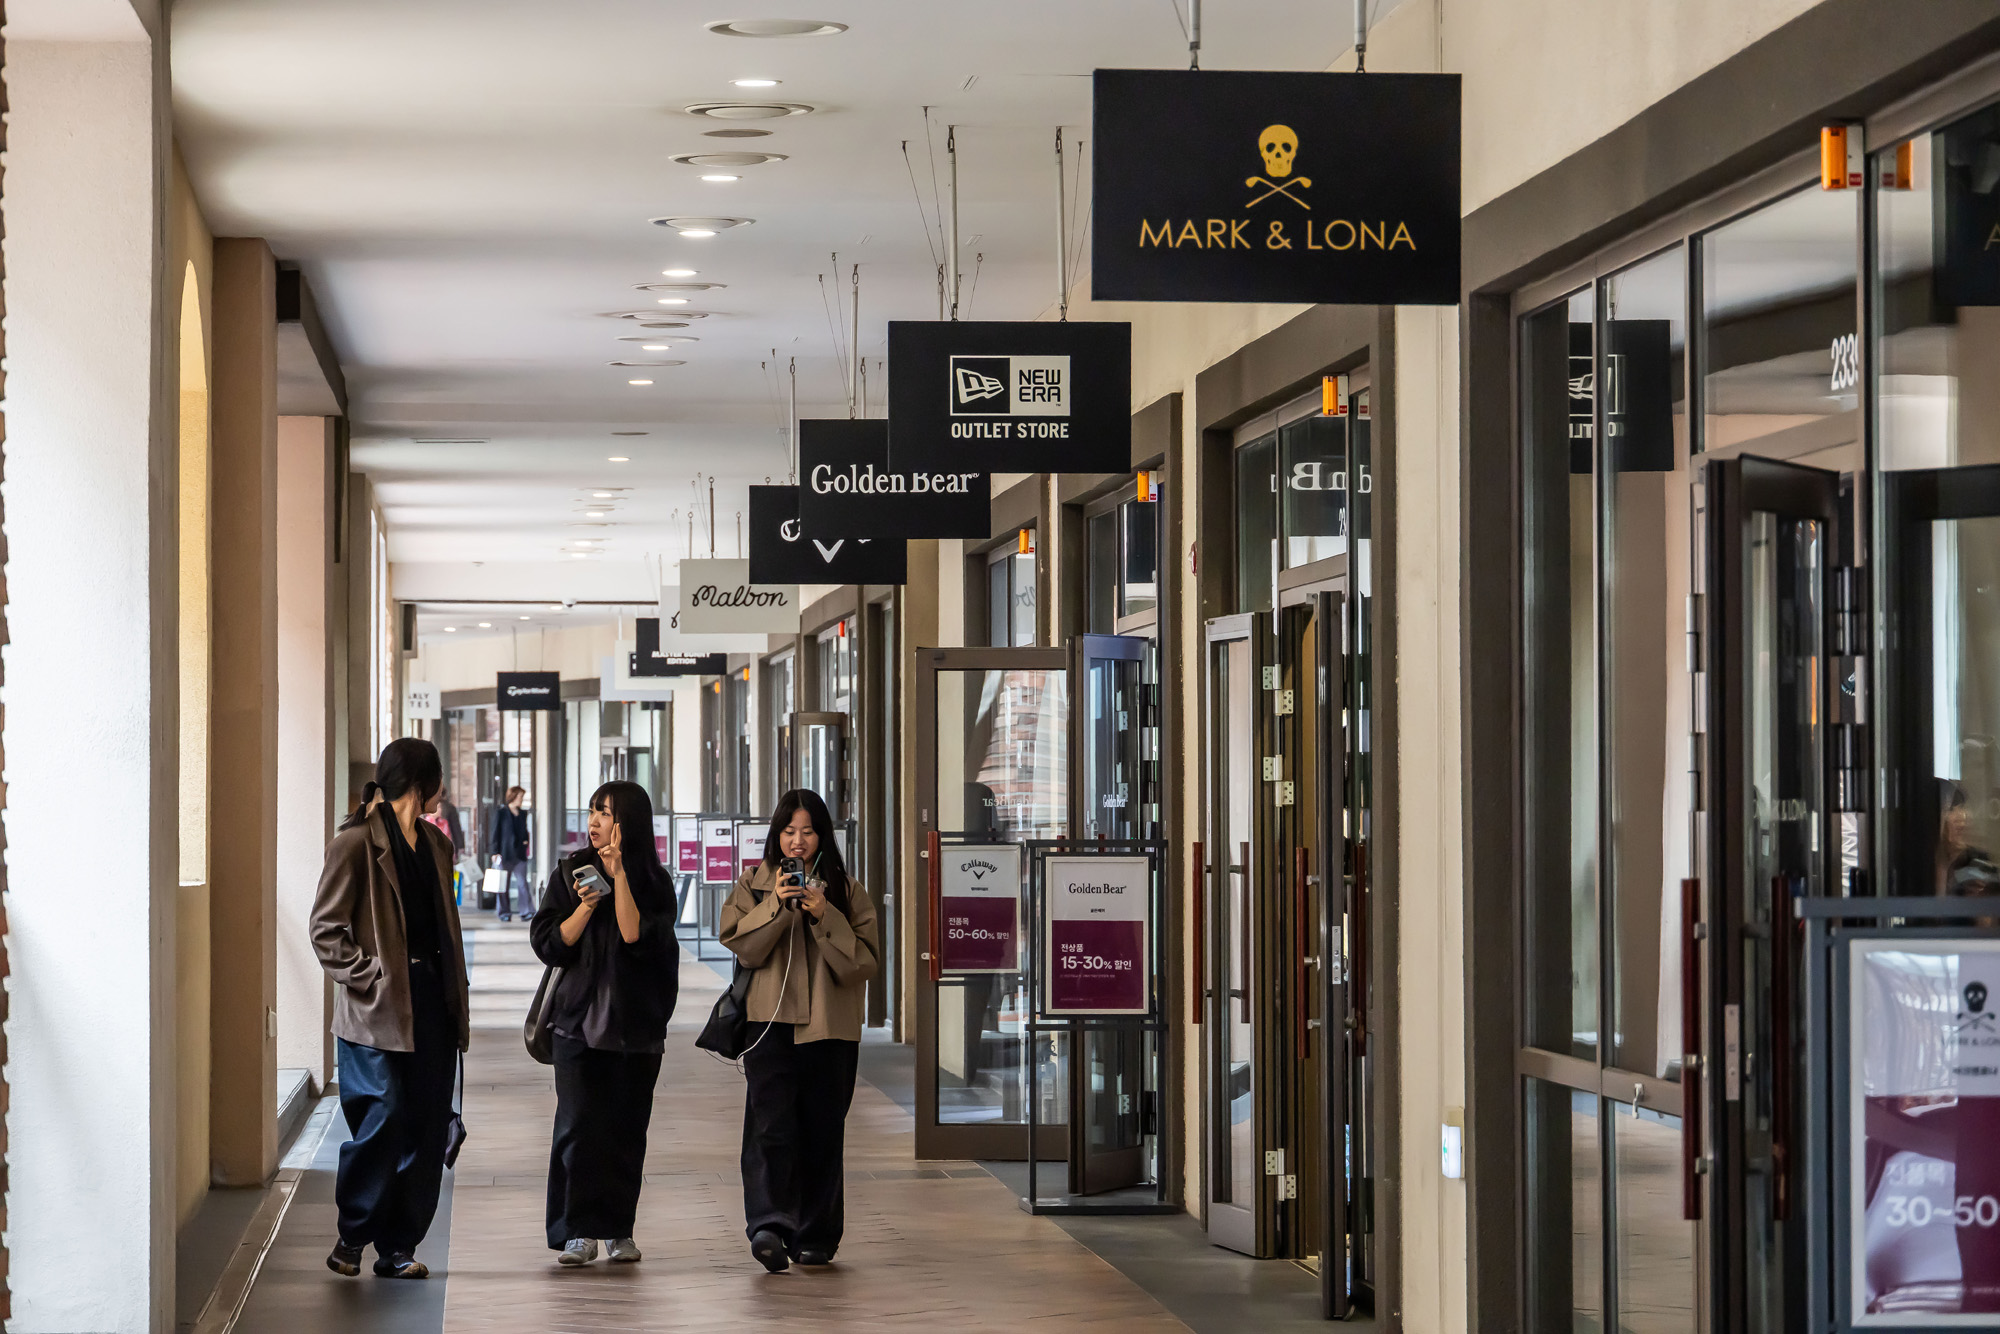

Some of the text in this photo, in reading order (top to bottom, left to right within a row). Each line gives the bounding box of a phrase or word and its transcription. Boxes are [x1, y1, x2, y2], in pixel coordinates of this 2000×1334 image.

[1139, 219, 1416, 250] MARK & LONA
[1019, 369, 1061, 385] NEW
[1019, 386, 1061, 403] ERA
[951, 423, 1069, 438] OUTLET STORE
[811, 464, 906, 494] Golden
[692, 585, 788, 607] Malbon
[961, 859, 998, 873] Callaway
[1068, 883, 1101, 894] Golden
[948, 929, 995, 940] 50~60%
[1061, 943, 1084, 953] 전상품
[1114, 960, 1132, 971] 할인
[1886, 1195, 2000, 1227] 30~50
